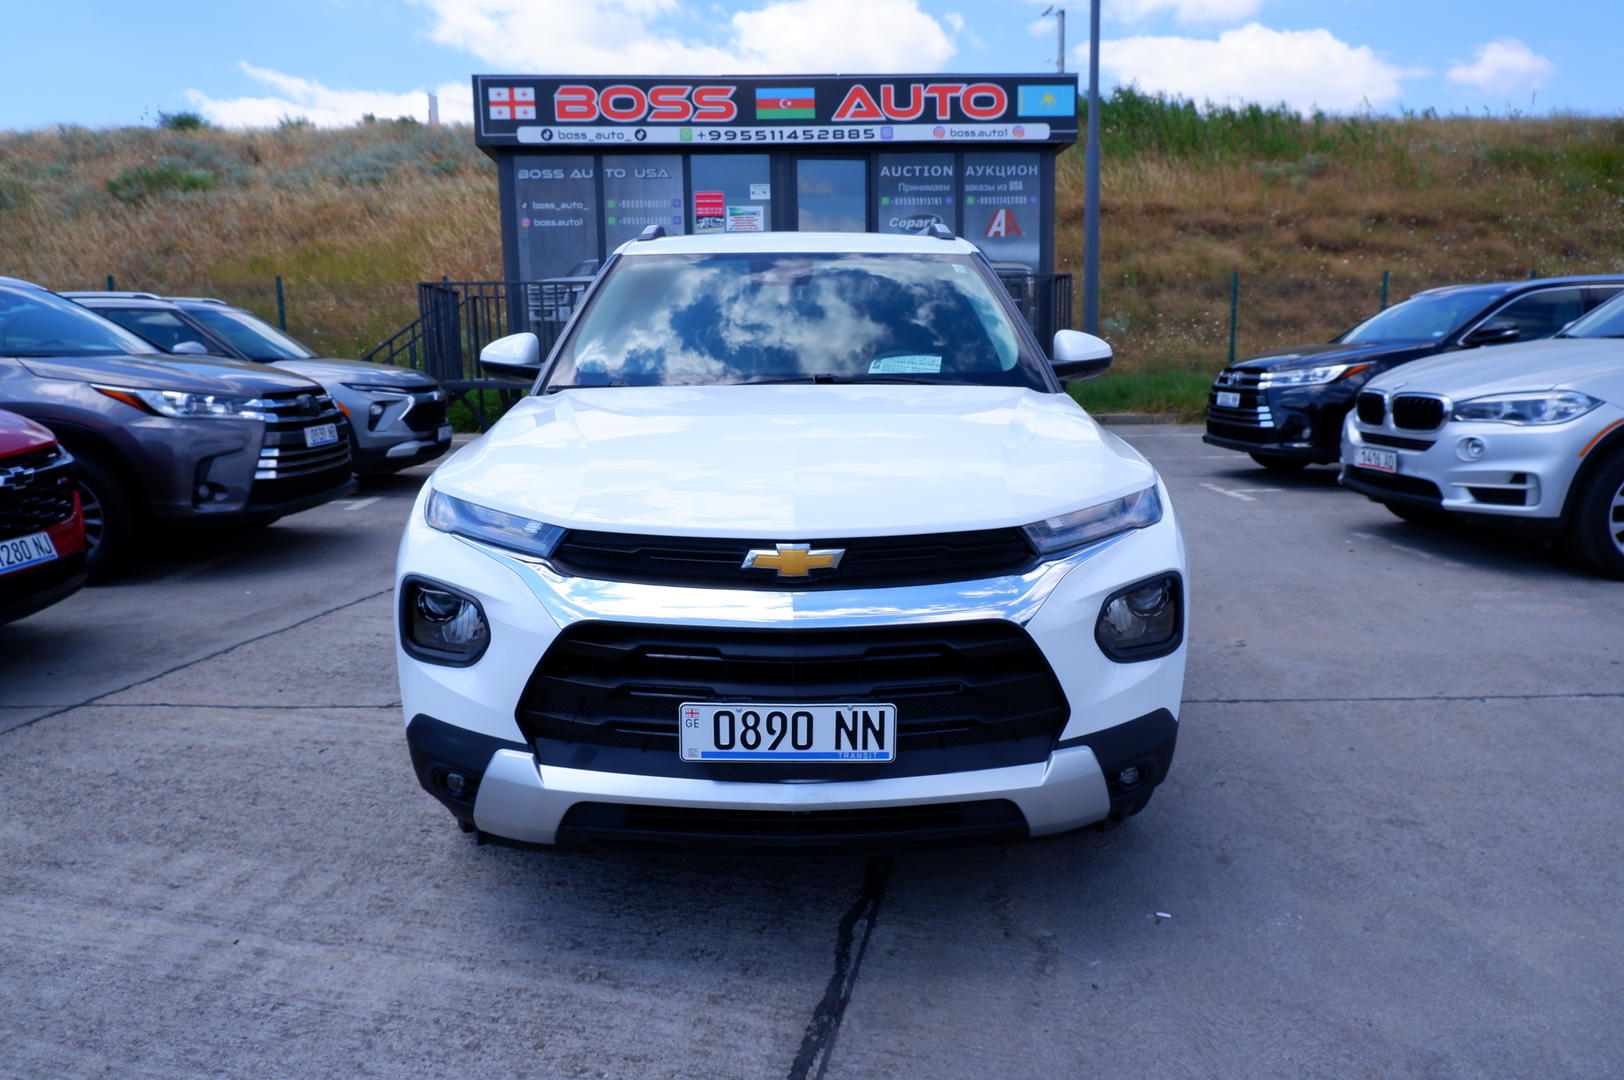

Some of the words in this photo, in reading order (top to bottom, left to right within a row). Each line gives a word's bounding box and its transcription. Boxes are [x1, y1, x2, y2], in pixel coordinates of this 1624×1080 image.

[554, 85, 738, 122] BOSS
[831, 83, 1008, 121] AUTO
[558, 130, 632, 142] boss_auto_
[697, 128, 875, 141] +995511452885
[950, 127, 1008, 138] boss.auto1
[518, 168, 565, 180] BOSS
[634, 168, 670, 179] USA
[880, 165, 953, 177] AUCTION
[965, 164, 1038, 178] АУКЦИОН
[898, 183, 950, 192] Принимаем
[964, 184, 995, 192] заказы
[1009, 180, 1023, 191] USA
[532, 201, 589, 211] boss_auto_
[533, 218, 583, 227] boss.auto1
[32, 535, 53, 556] NJ
[685, 719, 700, 728] GE
[713, 711, 814, 750] 0890
[835, 711, 886, 750] NN
